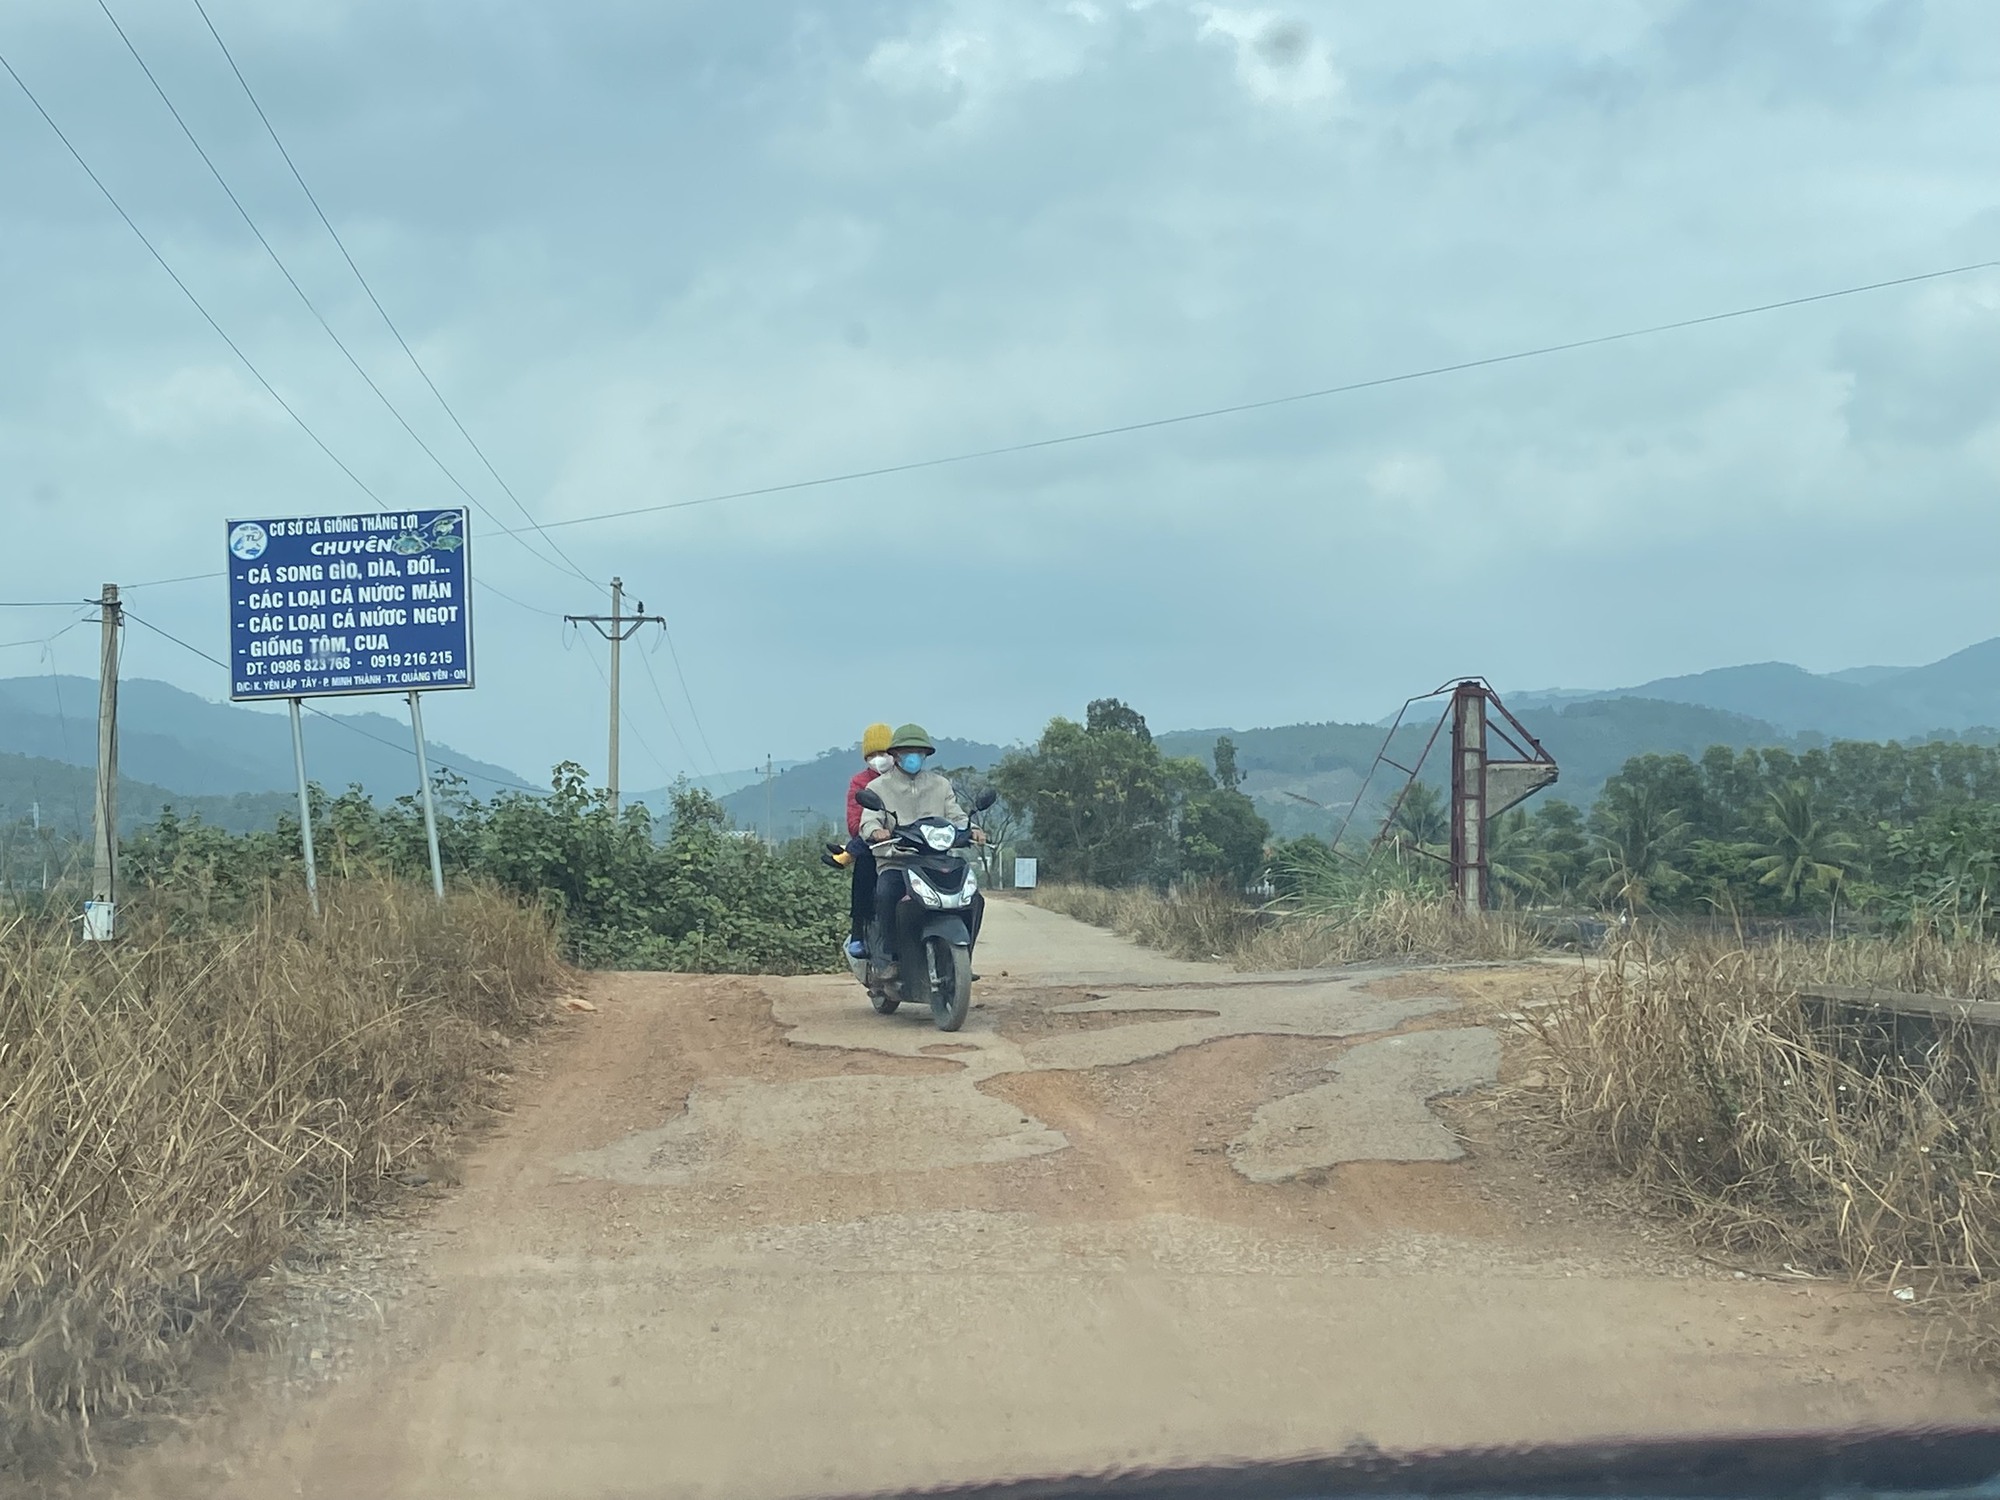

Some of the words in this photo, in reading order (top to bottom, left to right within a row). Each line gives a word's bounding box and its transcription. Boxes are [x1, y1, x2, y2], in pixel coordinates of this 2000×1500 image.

[270, 521, 285, 537] CƠ
[306, 518, 322, 535] CÁ
[324, 516, 359, 534] GIỐNG
[401, 514, 418, 532] LỢI
[311, 535, 393, 556] CHUYÊN
[248, 563, 272, 584] CÁ
[276, 564, 323, 583] SONG
[329, 559, 362, 580] GÌO,
[368, 558, 401, 578] DÌA,
[249, 589, 284, 610] CÁC
[288, 589, 326, 609] LOẠI
[331, 584, 354, 605] CÁ
[412, 580, 452, 602] MẶN
[249, 613, 284, 633] CÁC
[288, 614, 326, 633] LOẠI
[332, 607, 356, 629] CÁ
[413, 606, 458, 626] NGỌT
[250, 635, 303, 657] GIỐNG
[309, 634, 351, 654] TÔM,
[355, 634, 389, 652] CUA
[270, 659, 301, 674] 0986
[370, 654, 401, 669] 0919
[404, 652, 427, 667] 216
[429, 651, 453, 665] 215
[263, 678, 280, 691] YÊN
[301, 676, 318, 689] TÂY
[331, 676, 353, 687] MINH
[354, 672, 382, 686] THÀNH
[432, 668, 448, 681] YÊN
[454, 669, 466, 680] QN
